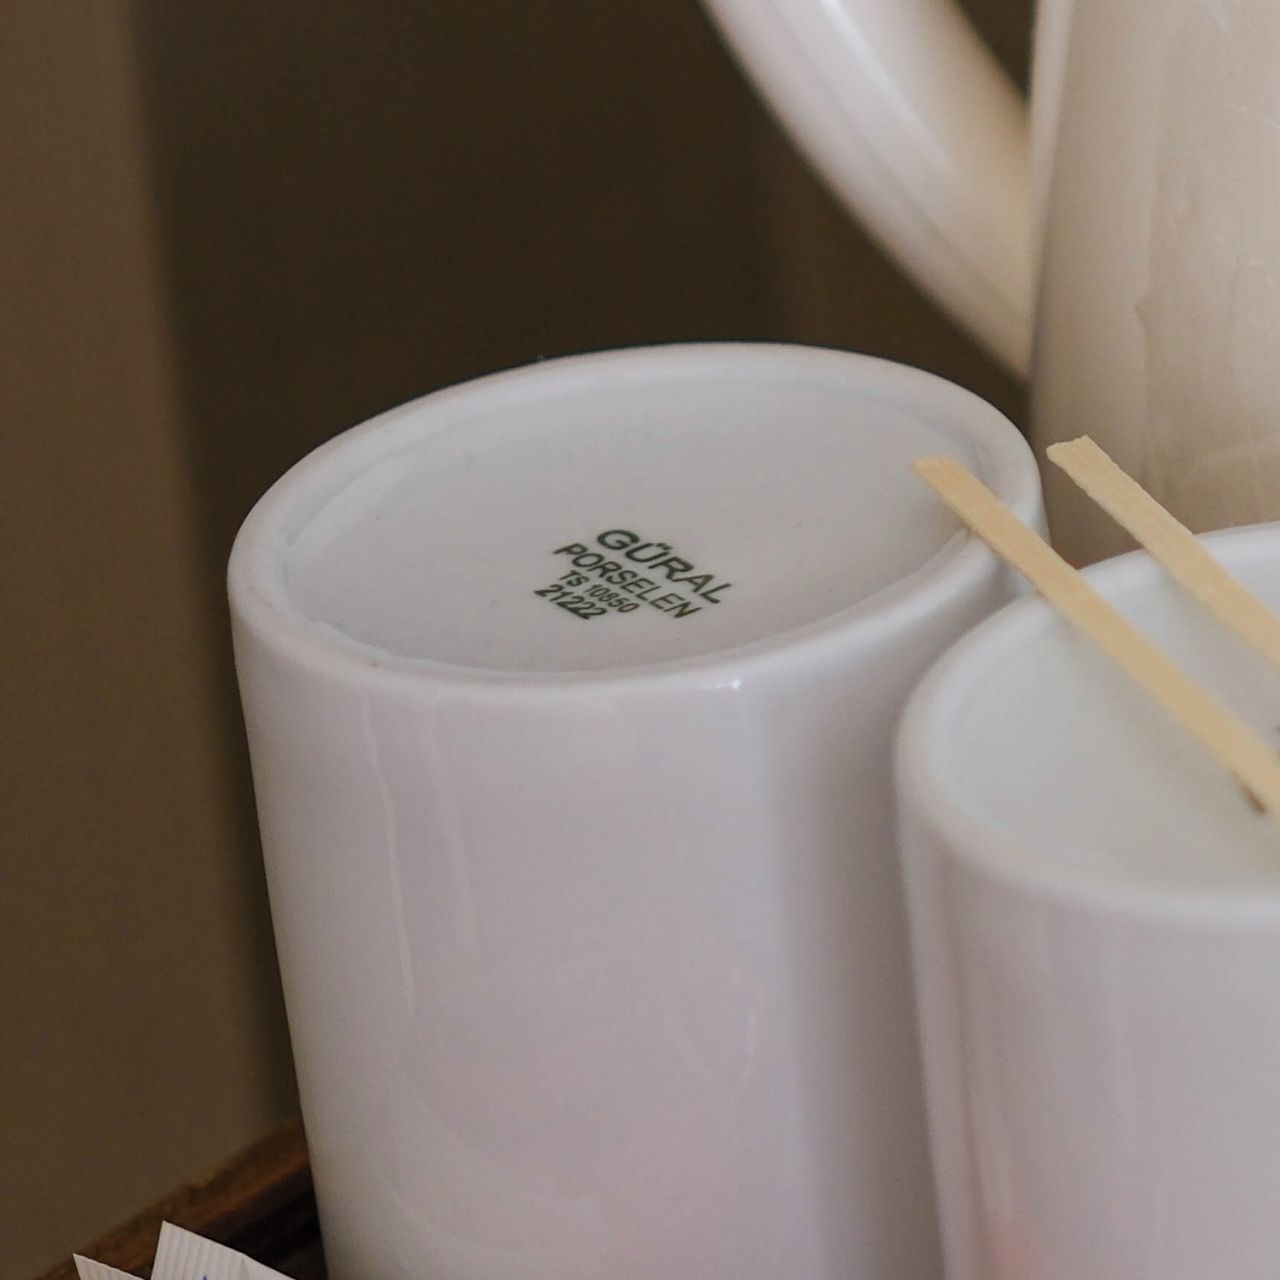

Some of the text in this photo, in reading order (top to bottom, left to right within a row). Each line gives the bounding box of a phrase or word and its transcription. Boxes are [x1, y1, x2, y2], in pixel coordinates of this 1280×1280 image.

[552, 543, 702, 619] PORSELEN
[559, 570, 640, 613] TS 10850
[597, 529, 732, 604] GÜRAL
